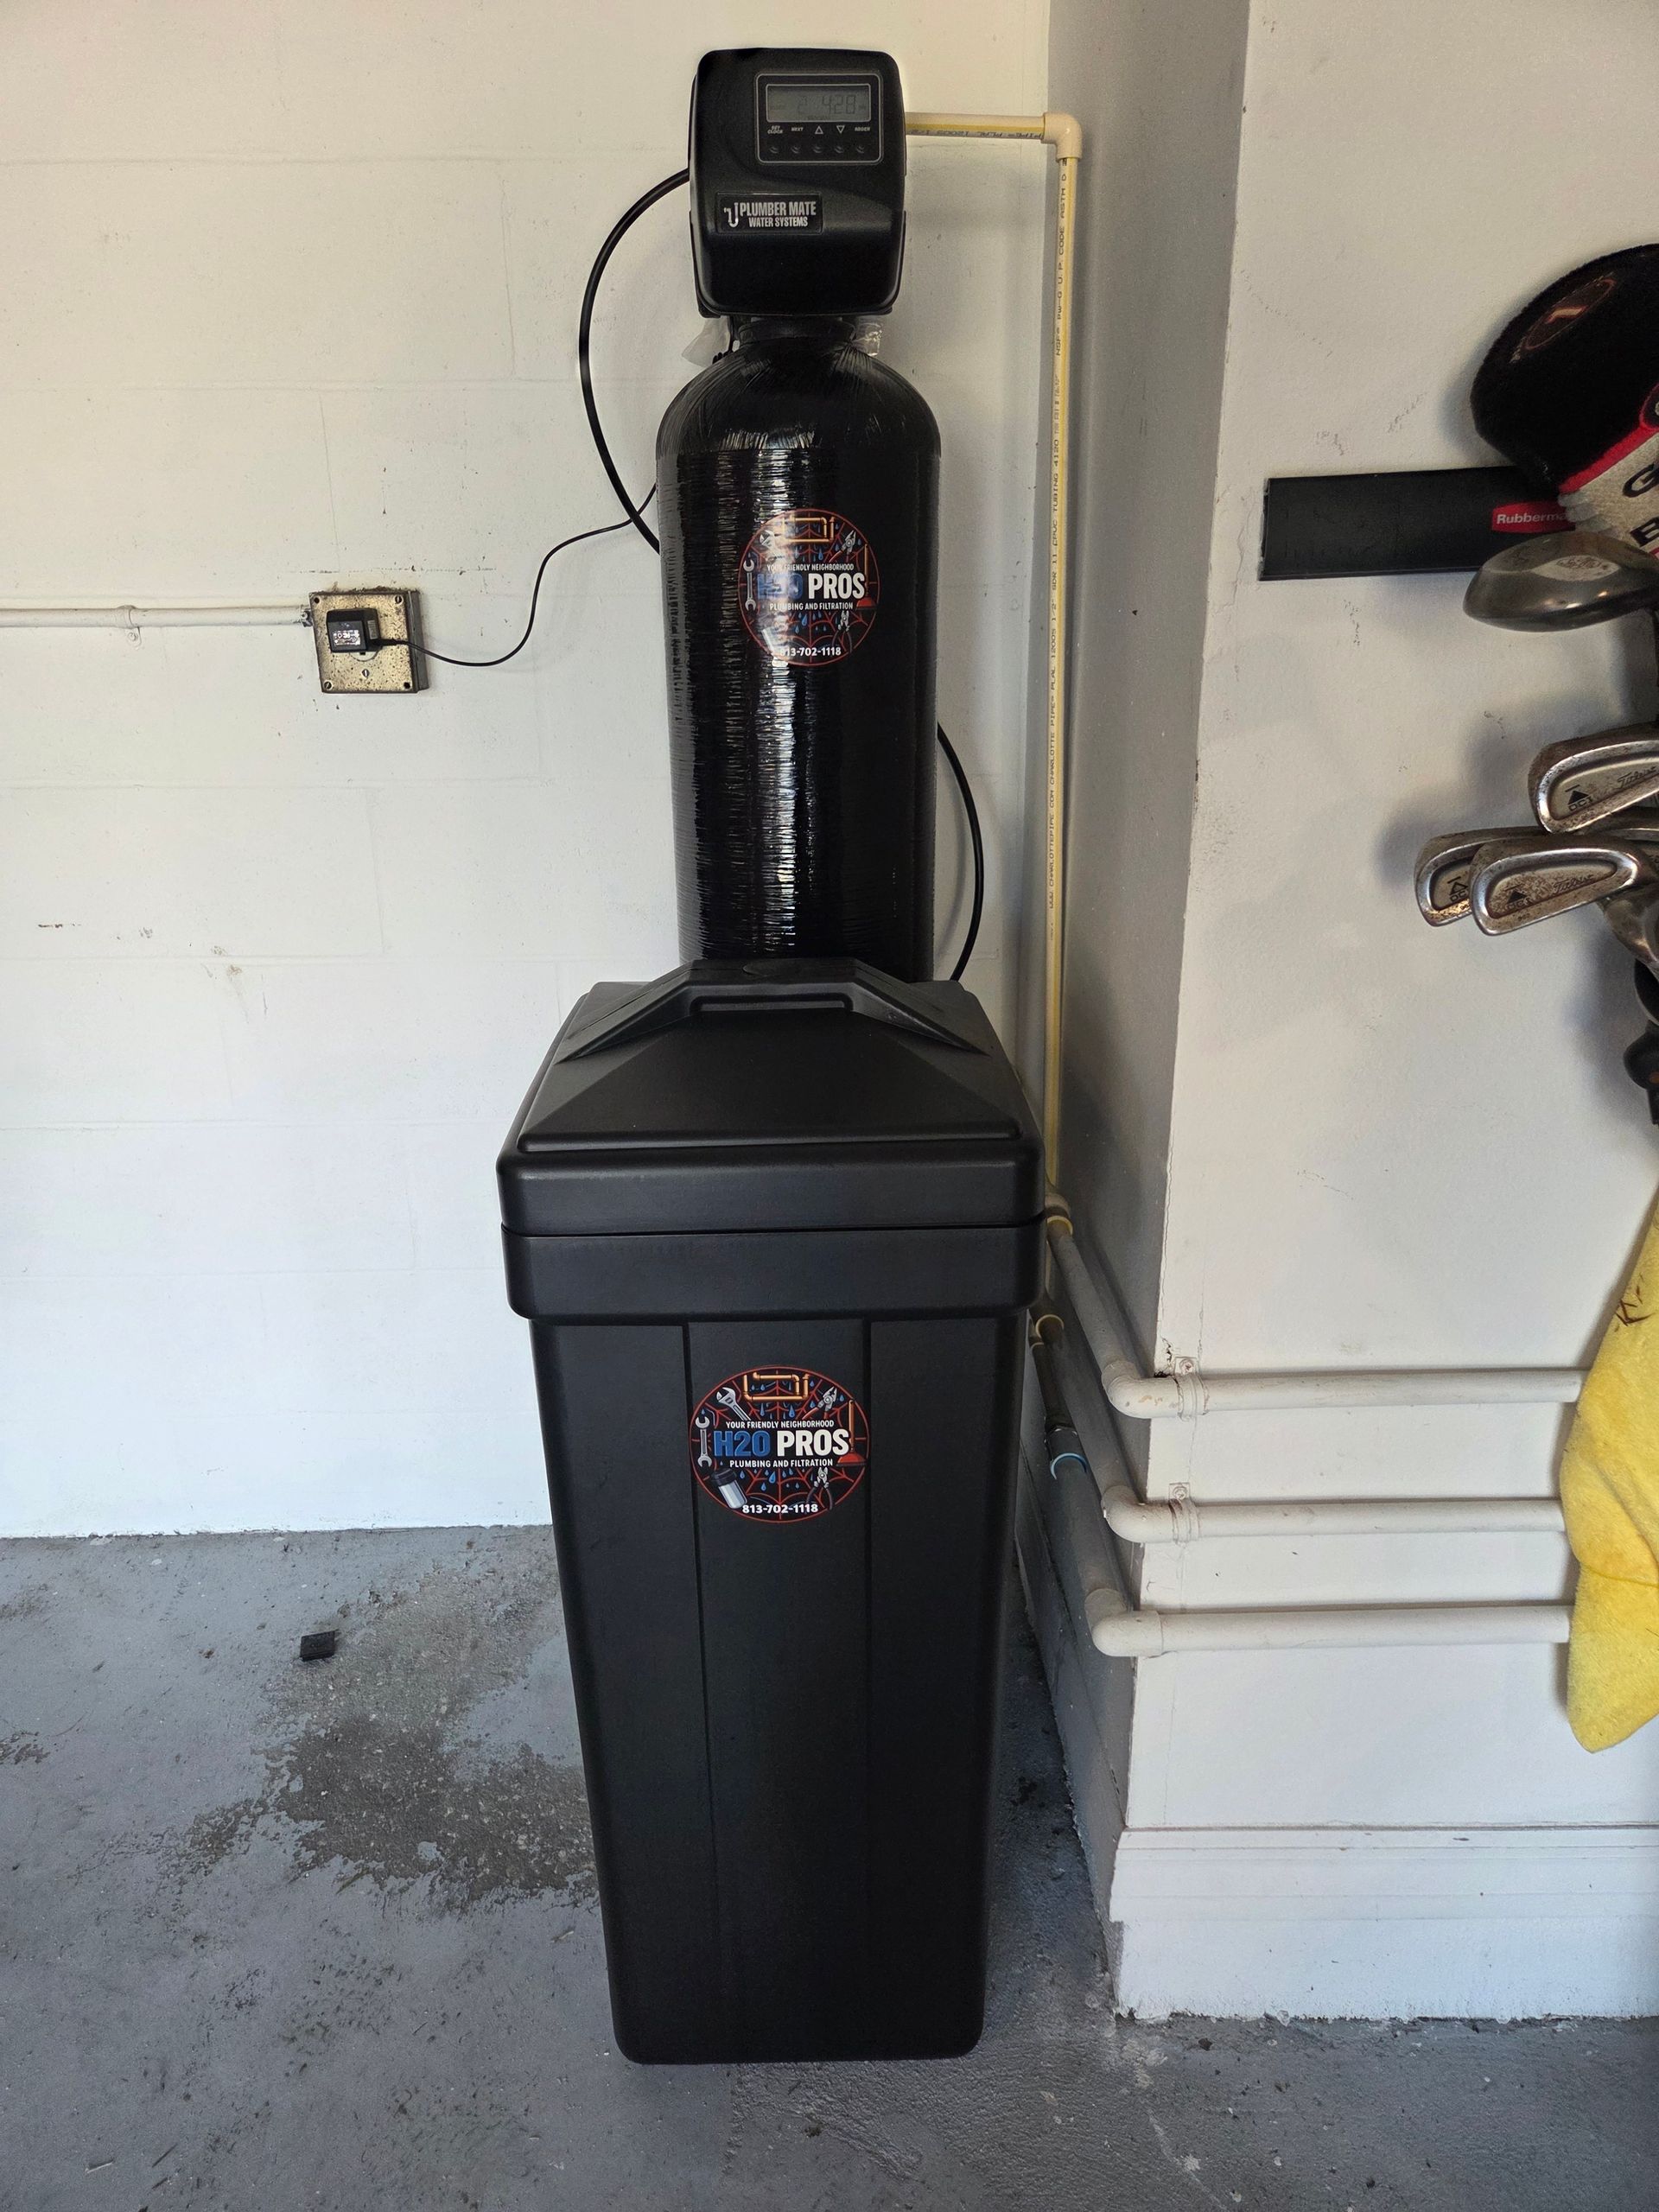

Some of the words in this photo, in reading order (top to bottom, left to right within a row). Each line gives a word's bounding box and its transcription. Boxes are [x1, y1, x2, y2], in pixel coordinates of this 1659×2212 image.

[740, 202, 786, 217] PLUMBER
[788, 201, 817, 216] MATE
[748, 217, 773, 227] WATER
[775, 216, 808, 227] SYSTEMS
[1496, 512, 1568, 524] Rubberma
[808, 572, 865, 599] PROS
[770, 602, 804, 611] PLUMBING
[726, 1421, 746, 1429] YOUR
[747, 1421, 779, 1429] FRIENDLY
[781, 1420, 835, 1428] NEIGHBORHOOD
[777, 1428, 849, 1457] PROS
[730, 1459, 771, 1468] PLUMBING
[742, 1503, 818, 1514] 813-702-1118
